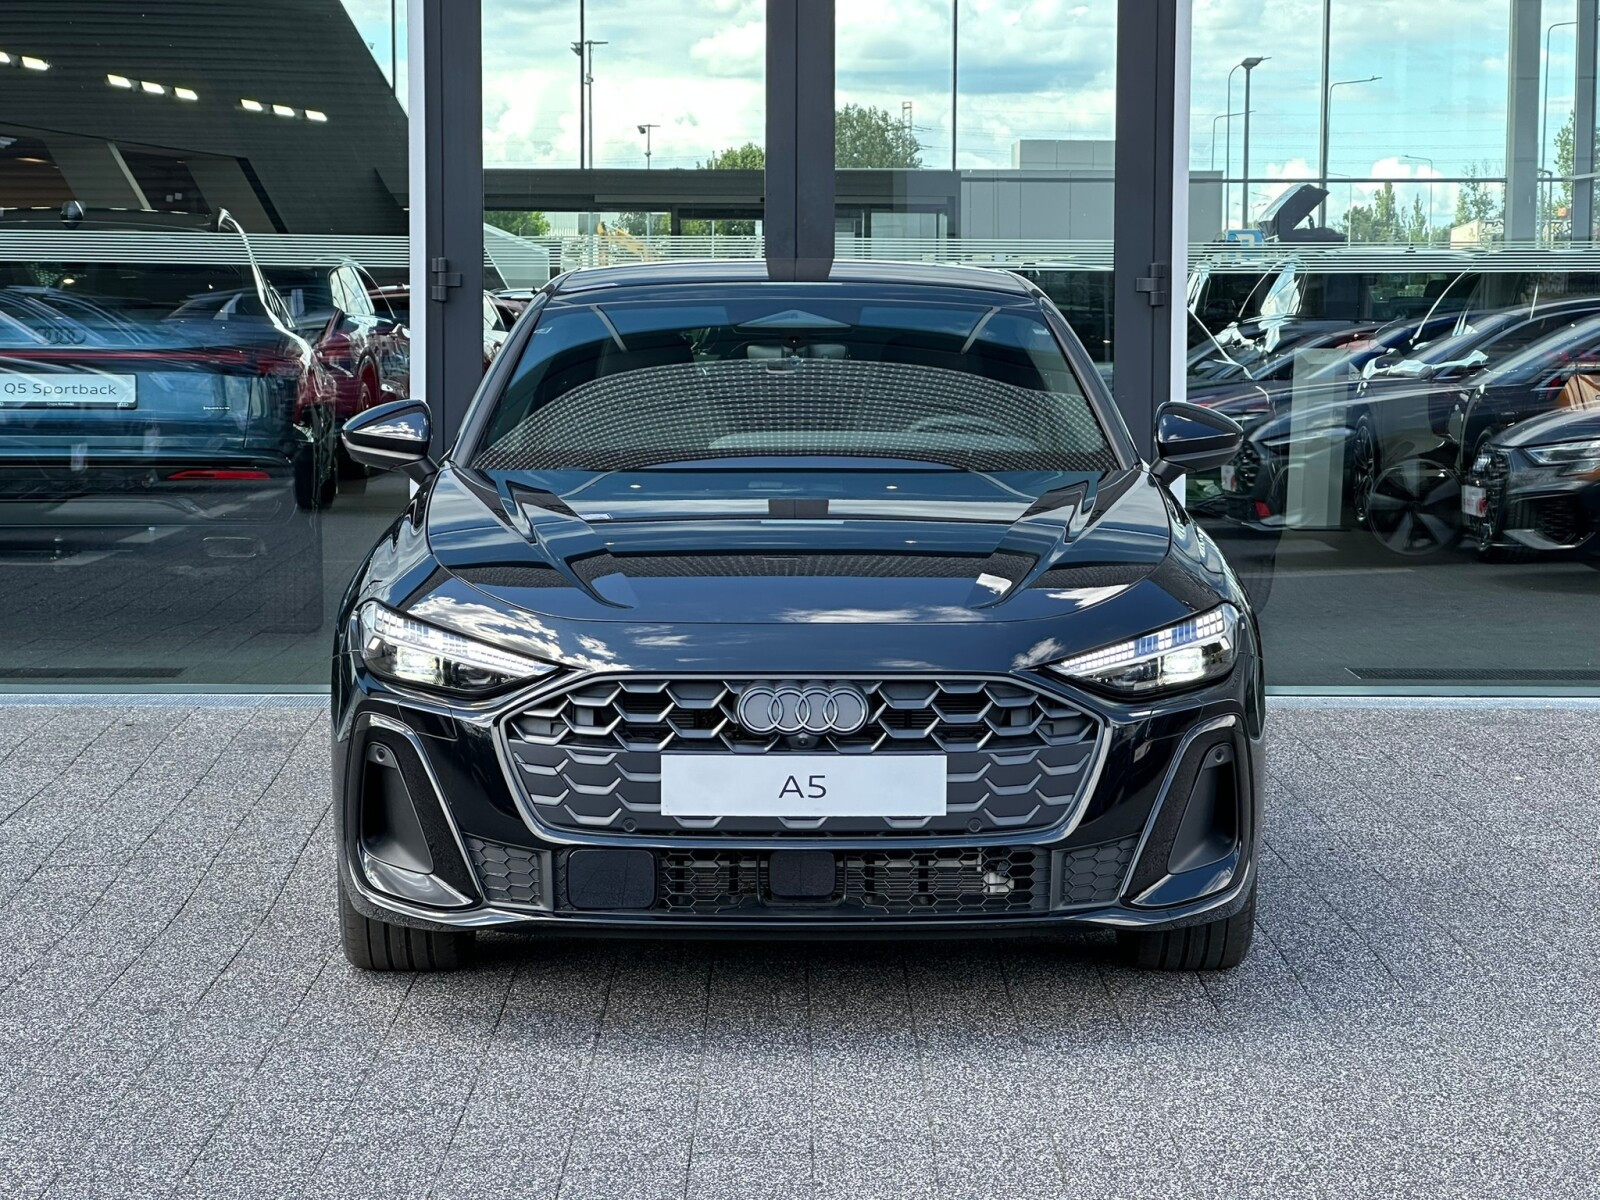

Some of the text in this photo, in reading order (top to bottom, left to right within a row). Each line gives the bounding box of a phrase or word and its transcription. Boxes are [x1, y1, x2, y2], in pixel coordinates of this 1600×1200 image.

[4, 383, 117, 396] Q5 Sportback
[778, 775, 827, 799] A5
